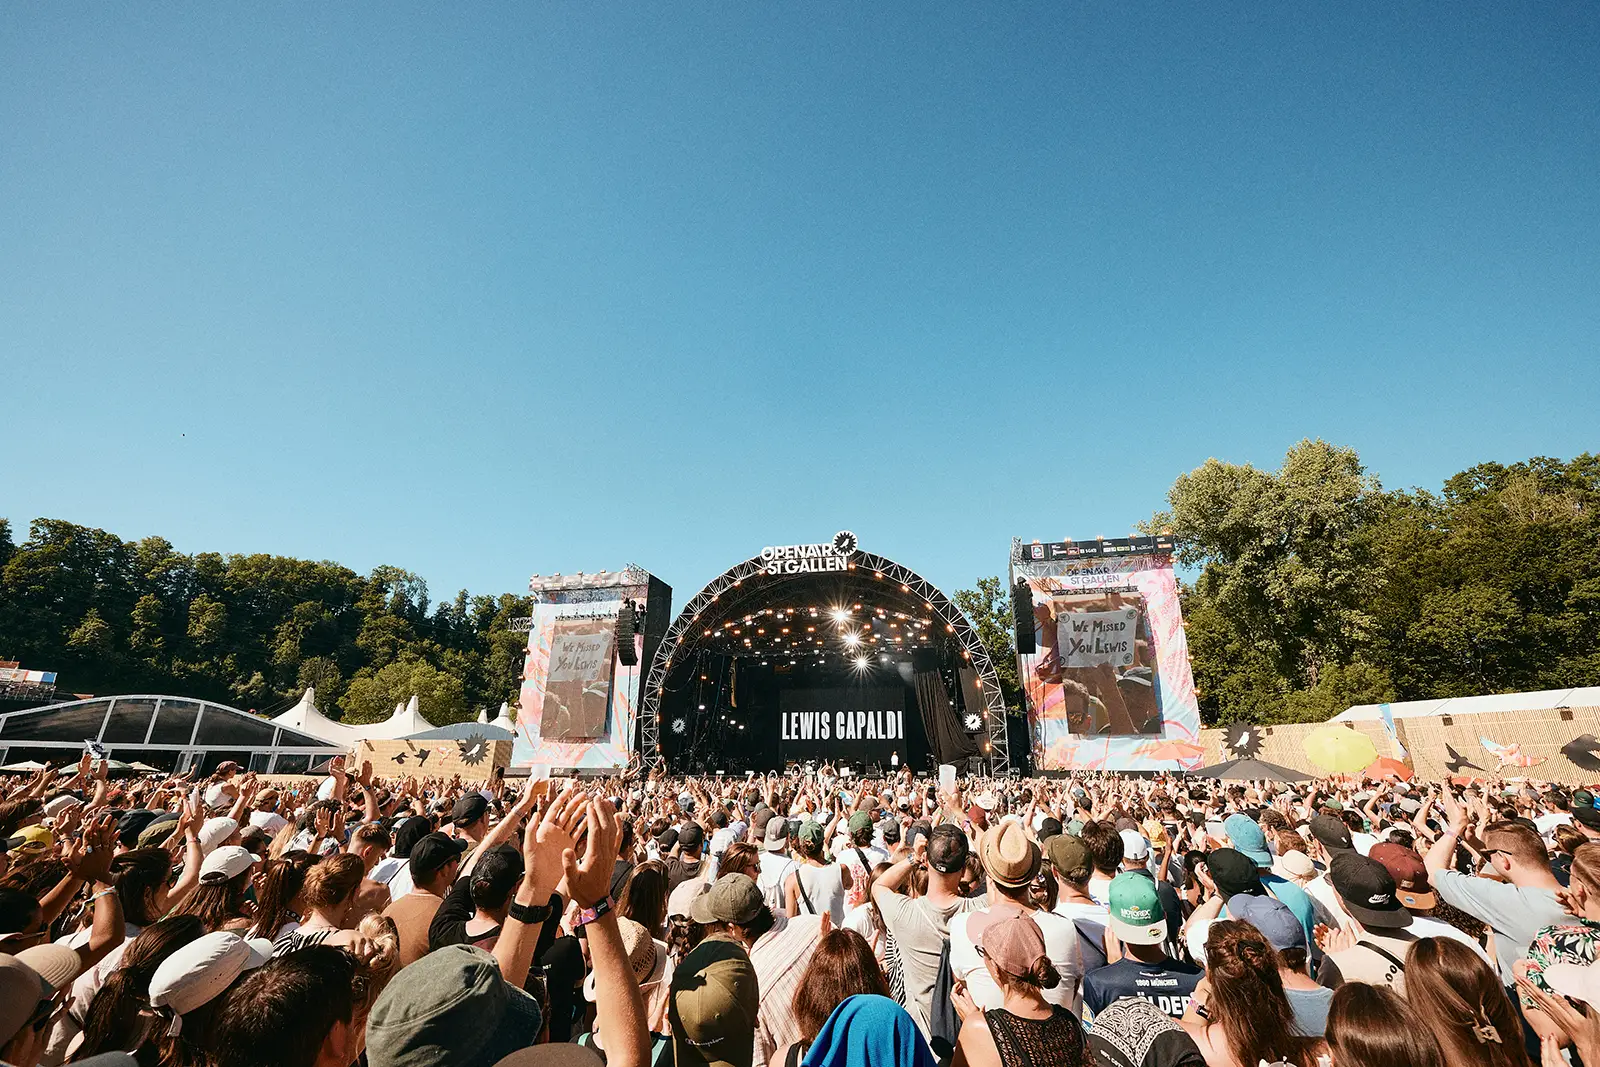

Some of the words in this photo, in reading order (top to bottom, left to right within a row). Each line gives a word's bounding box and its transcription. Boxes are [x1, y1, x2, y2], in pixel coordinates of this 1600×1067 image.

[760, 543, 833, 560] OPENAIR
[767, 559, 783, 575] ST
[784, 556, 848, 574] GALLEN
[1081, 574, 1120, 584] GALLEN
[781, 711, 831, 740] LEWIS
[835, 710, 904, 740] CAPALDI
